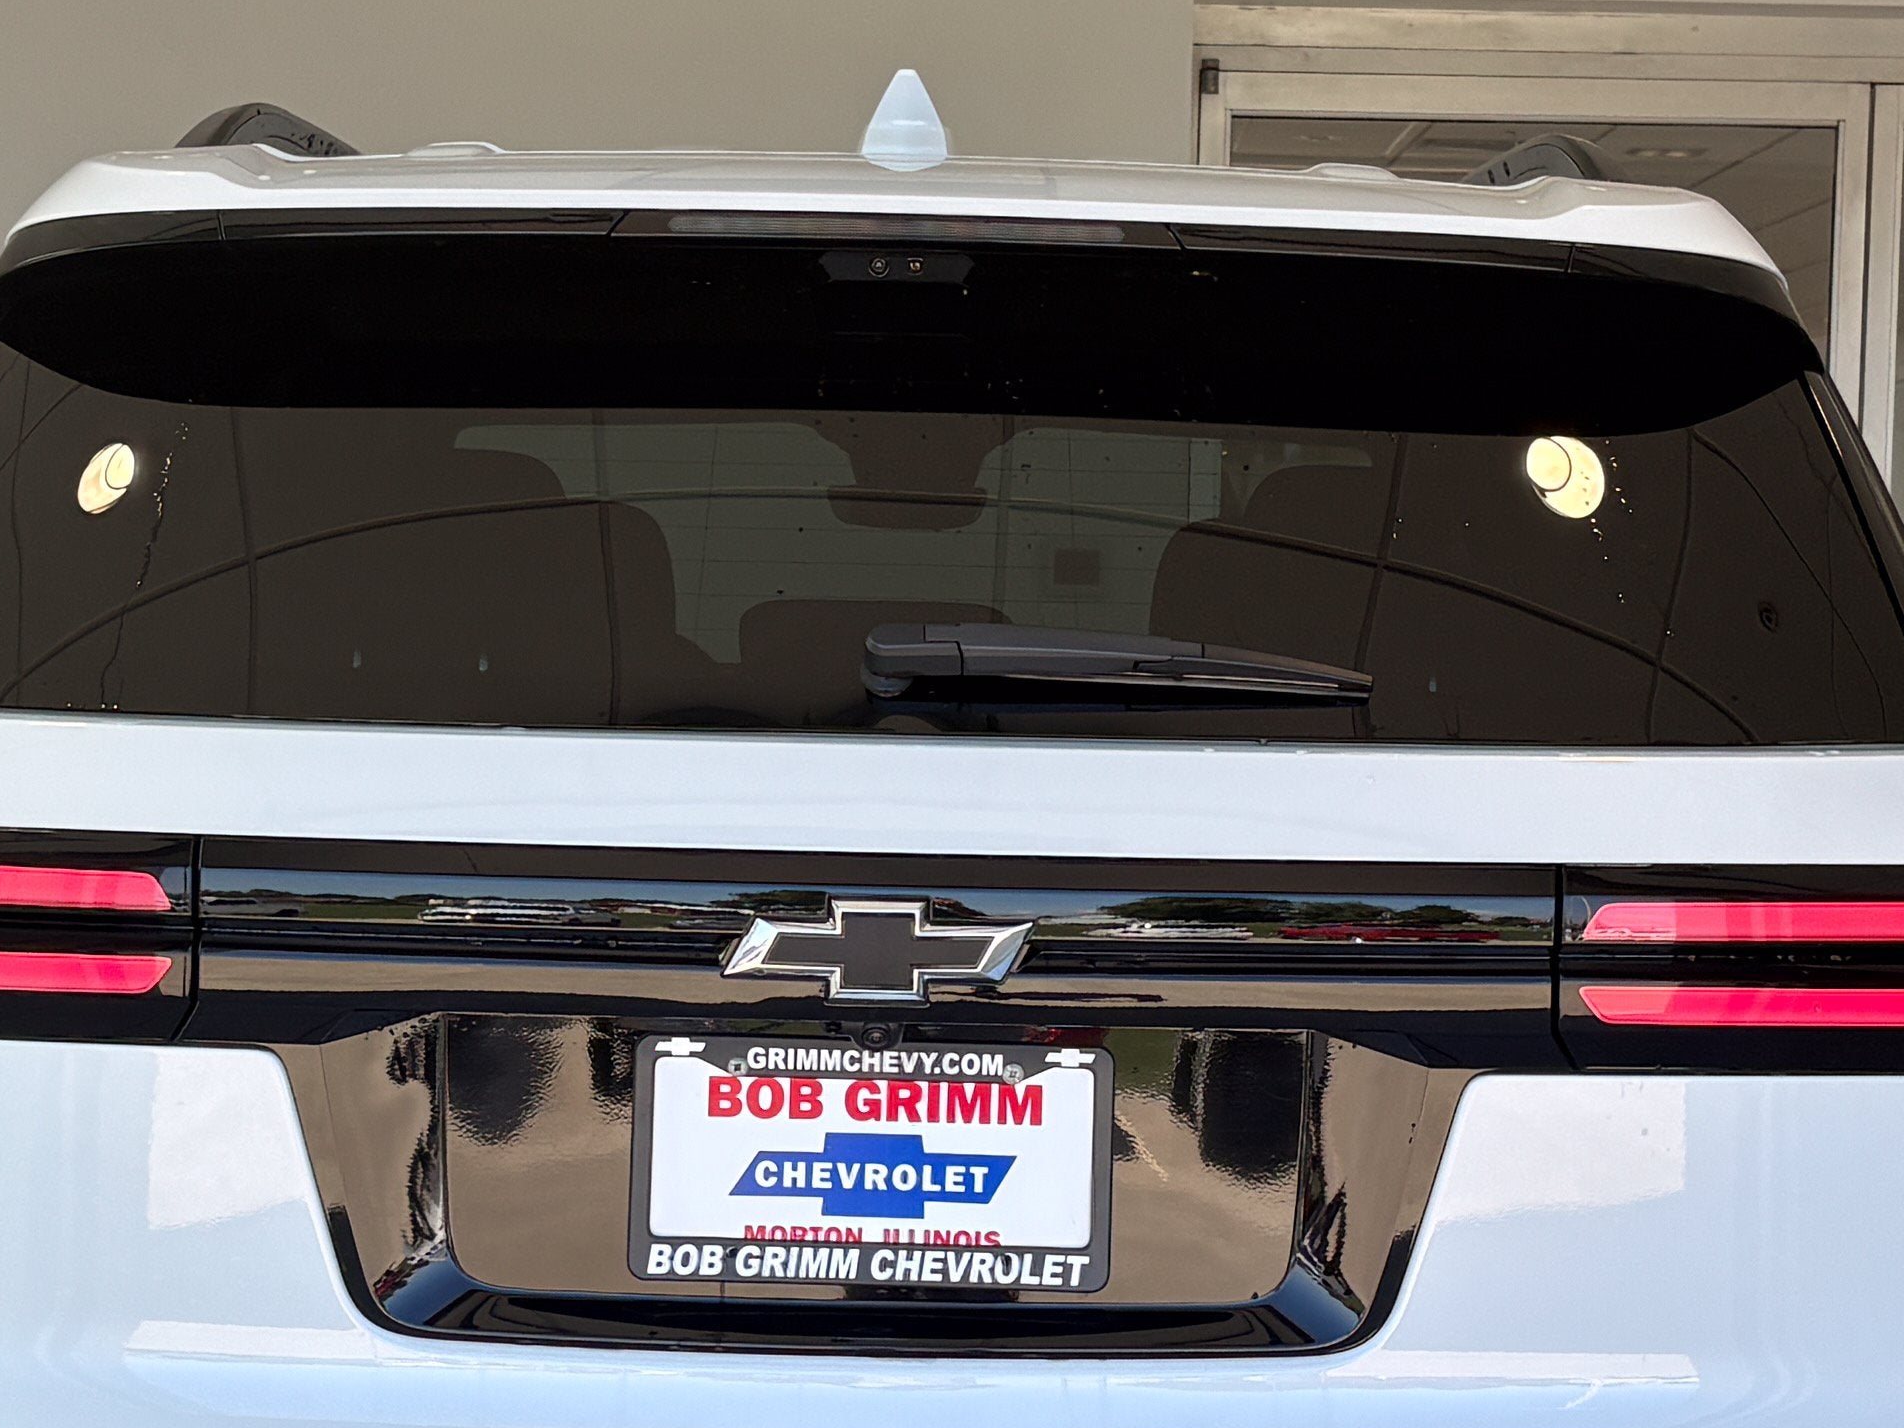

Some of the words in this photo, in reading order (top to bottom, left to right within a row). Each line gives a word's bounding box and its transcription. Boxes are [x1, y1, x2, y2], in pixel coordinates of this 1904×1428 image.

[746, 1045, 1005, 1077] GRIMMCHEVY.COM
[706, 1075, 825, 1120] BOB
[844, 1079, 1044, 1127] GRIMM
[753, 1159, 991, 1194] CHEVROLET
[743, 1224, 864, 1244] MORTON
[646, 1242, 725, 1277] BOB
[733, 1246, 860, 1281] GRIMM
[869, 1248, 1092, 1288] CHEVROLET
